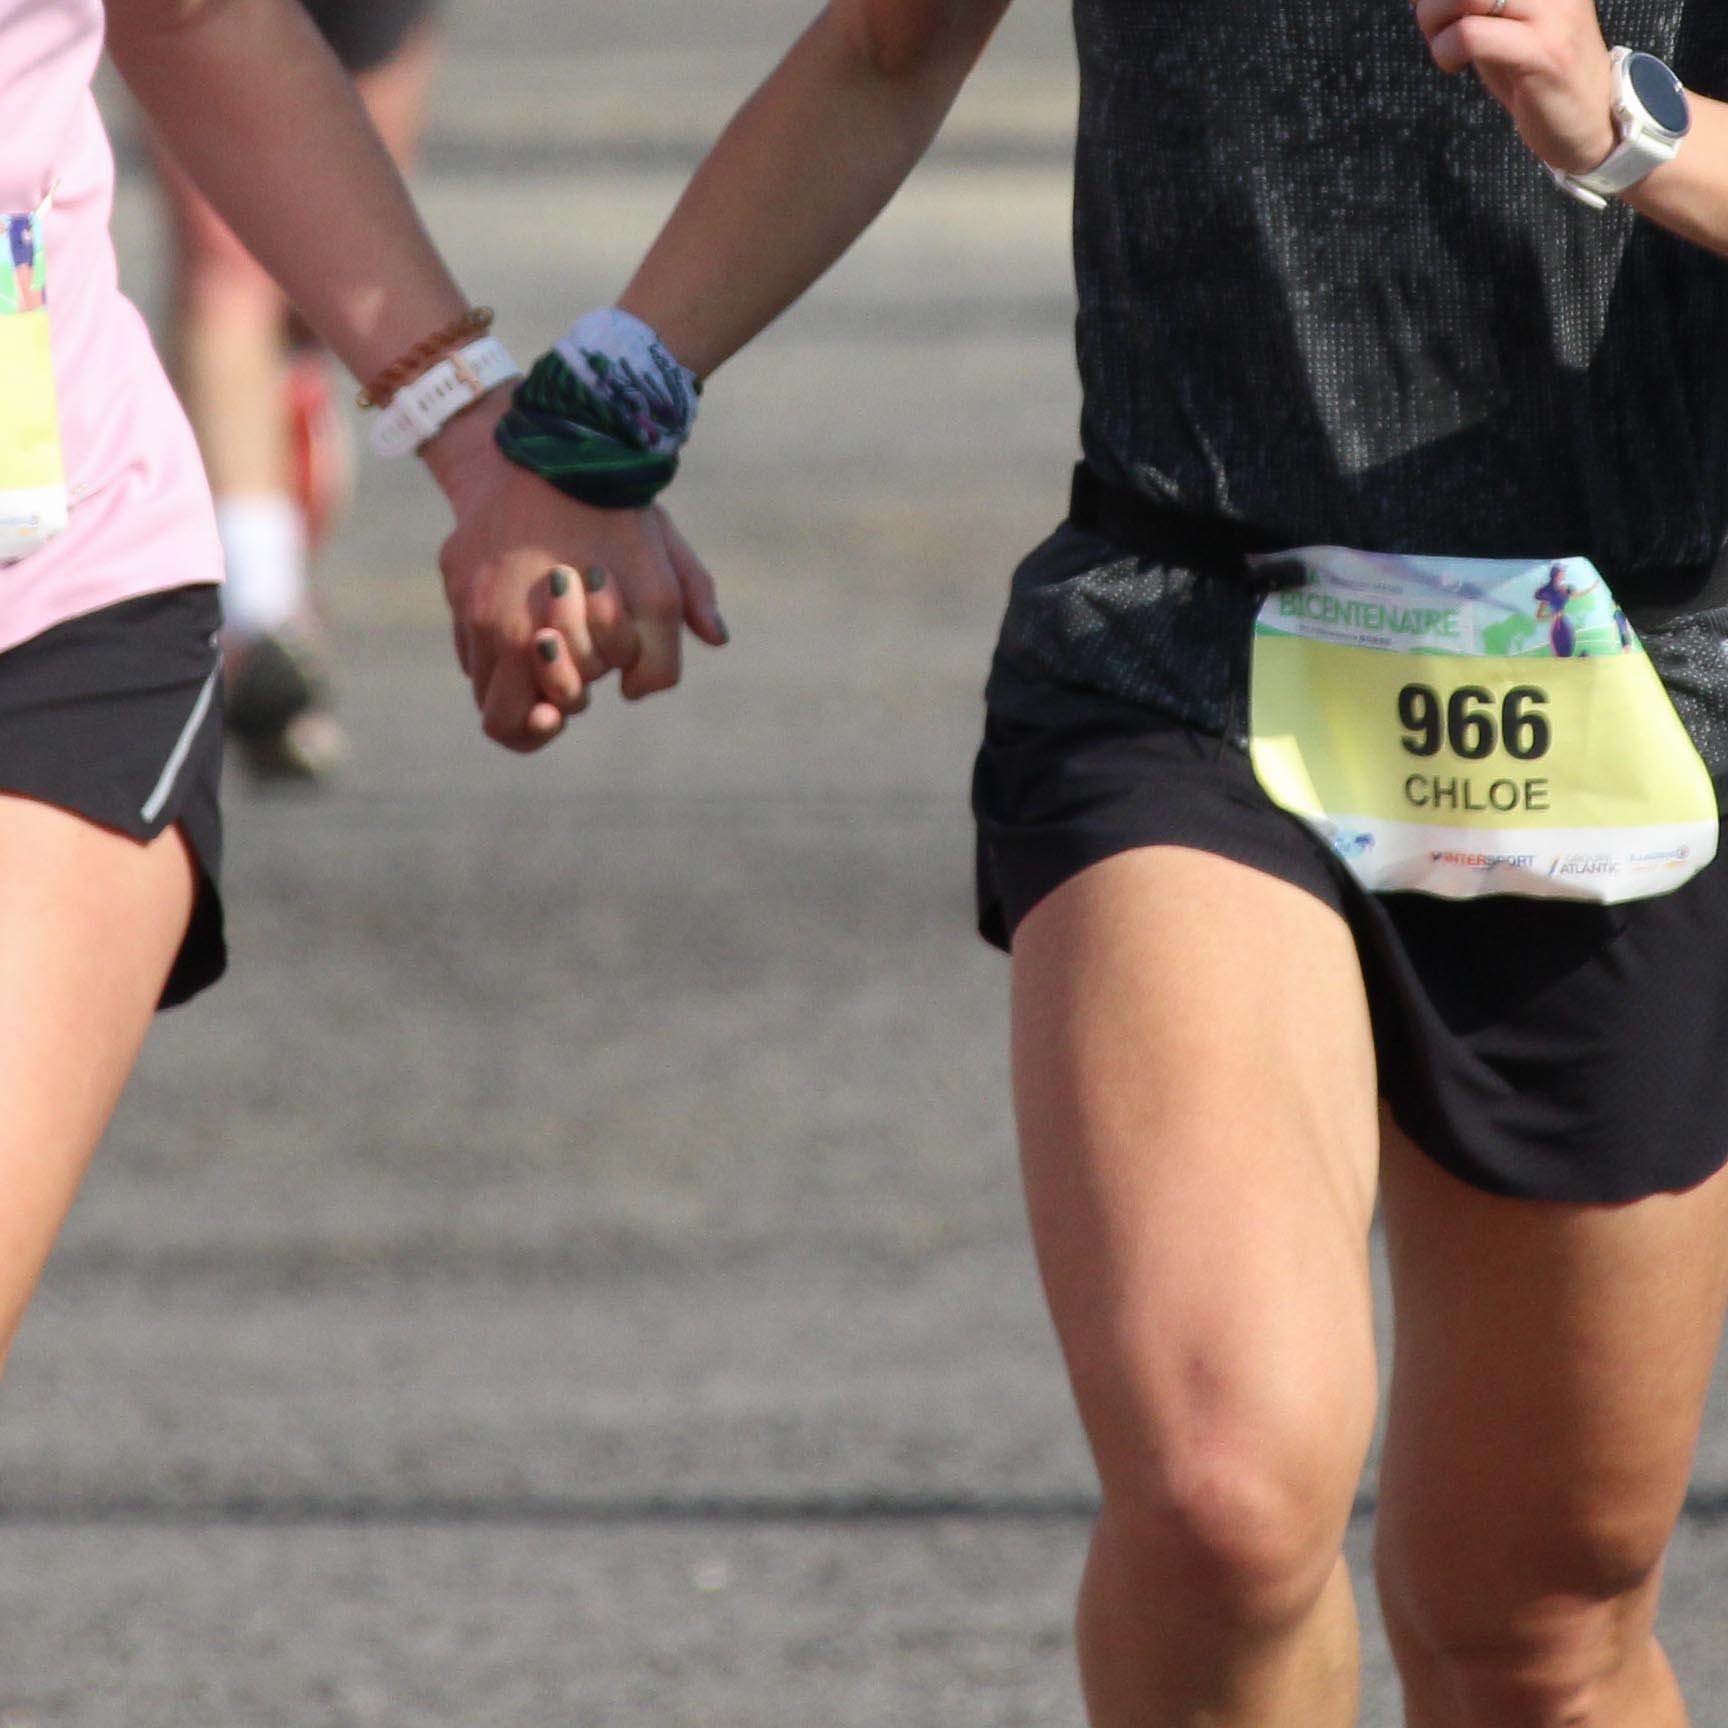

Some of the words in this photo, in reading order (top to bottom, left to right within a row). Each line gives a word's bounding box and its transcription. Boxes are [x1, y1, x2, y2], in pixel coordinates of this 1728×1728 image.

[1278, 588, 1461, 638] BICENTENAIRE
[1396, 682, 1553, 761] 966
[1403, 772, 1552, 812] CHLOE
[1442, 852, 1536, 868] INTERSPORT
